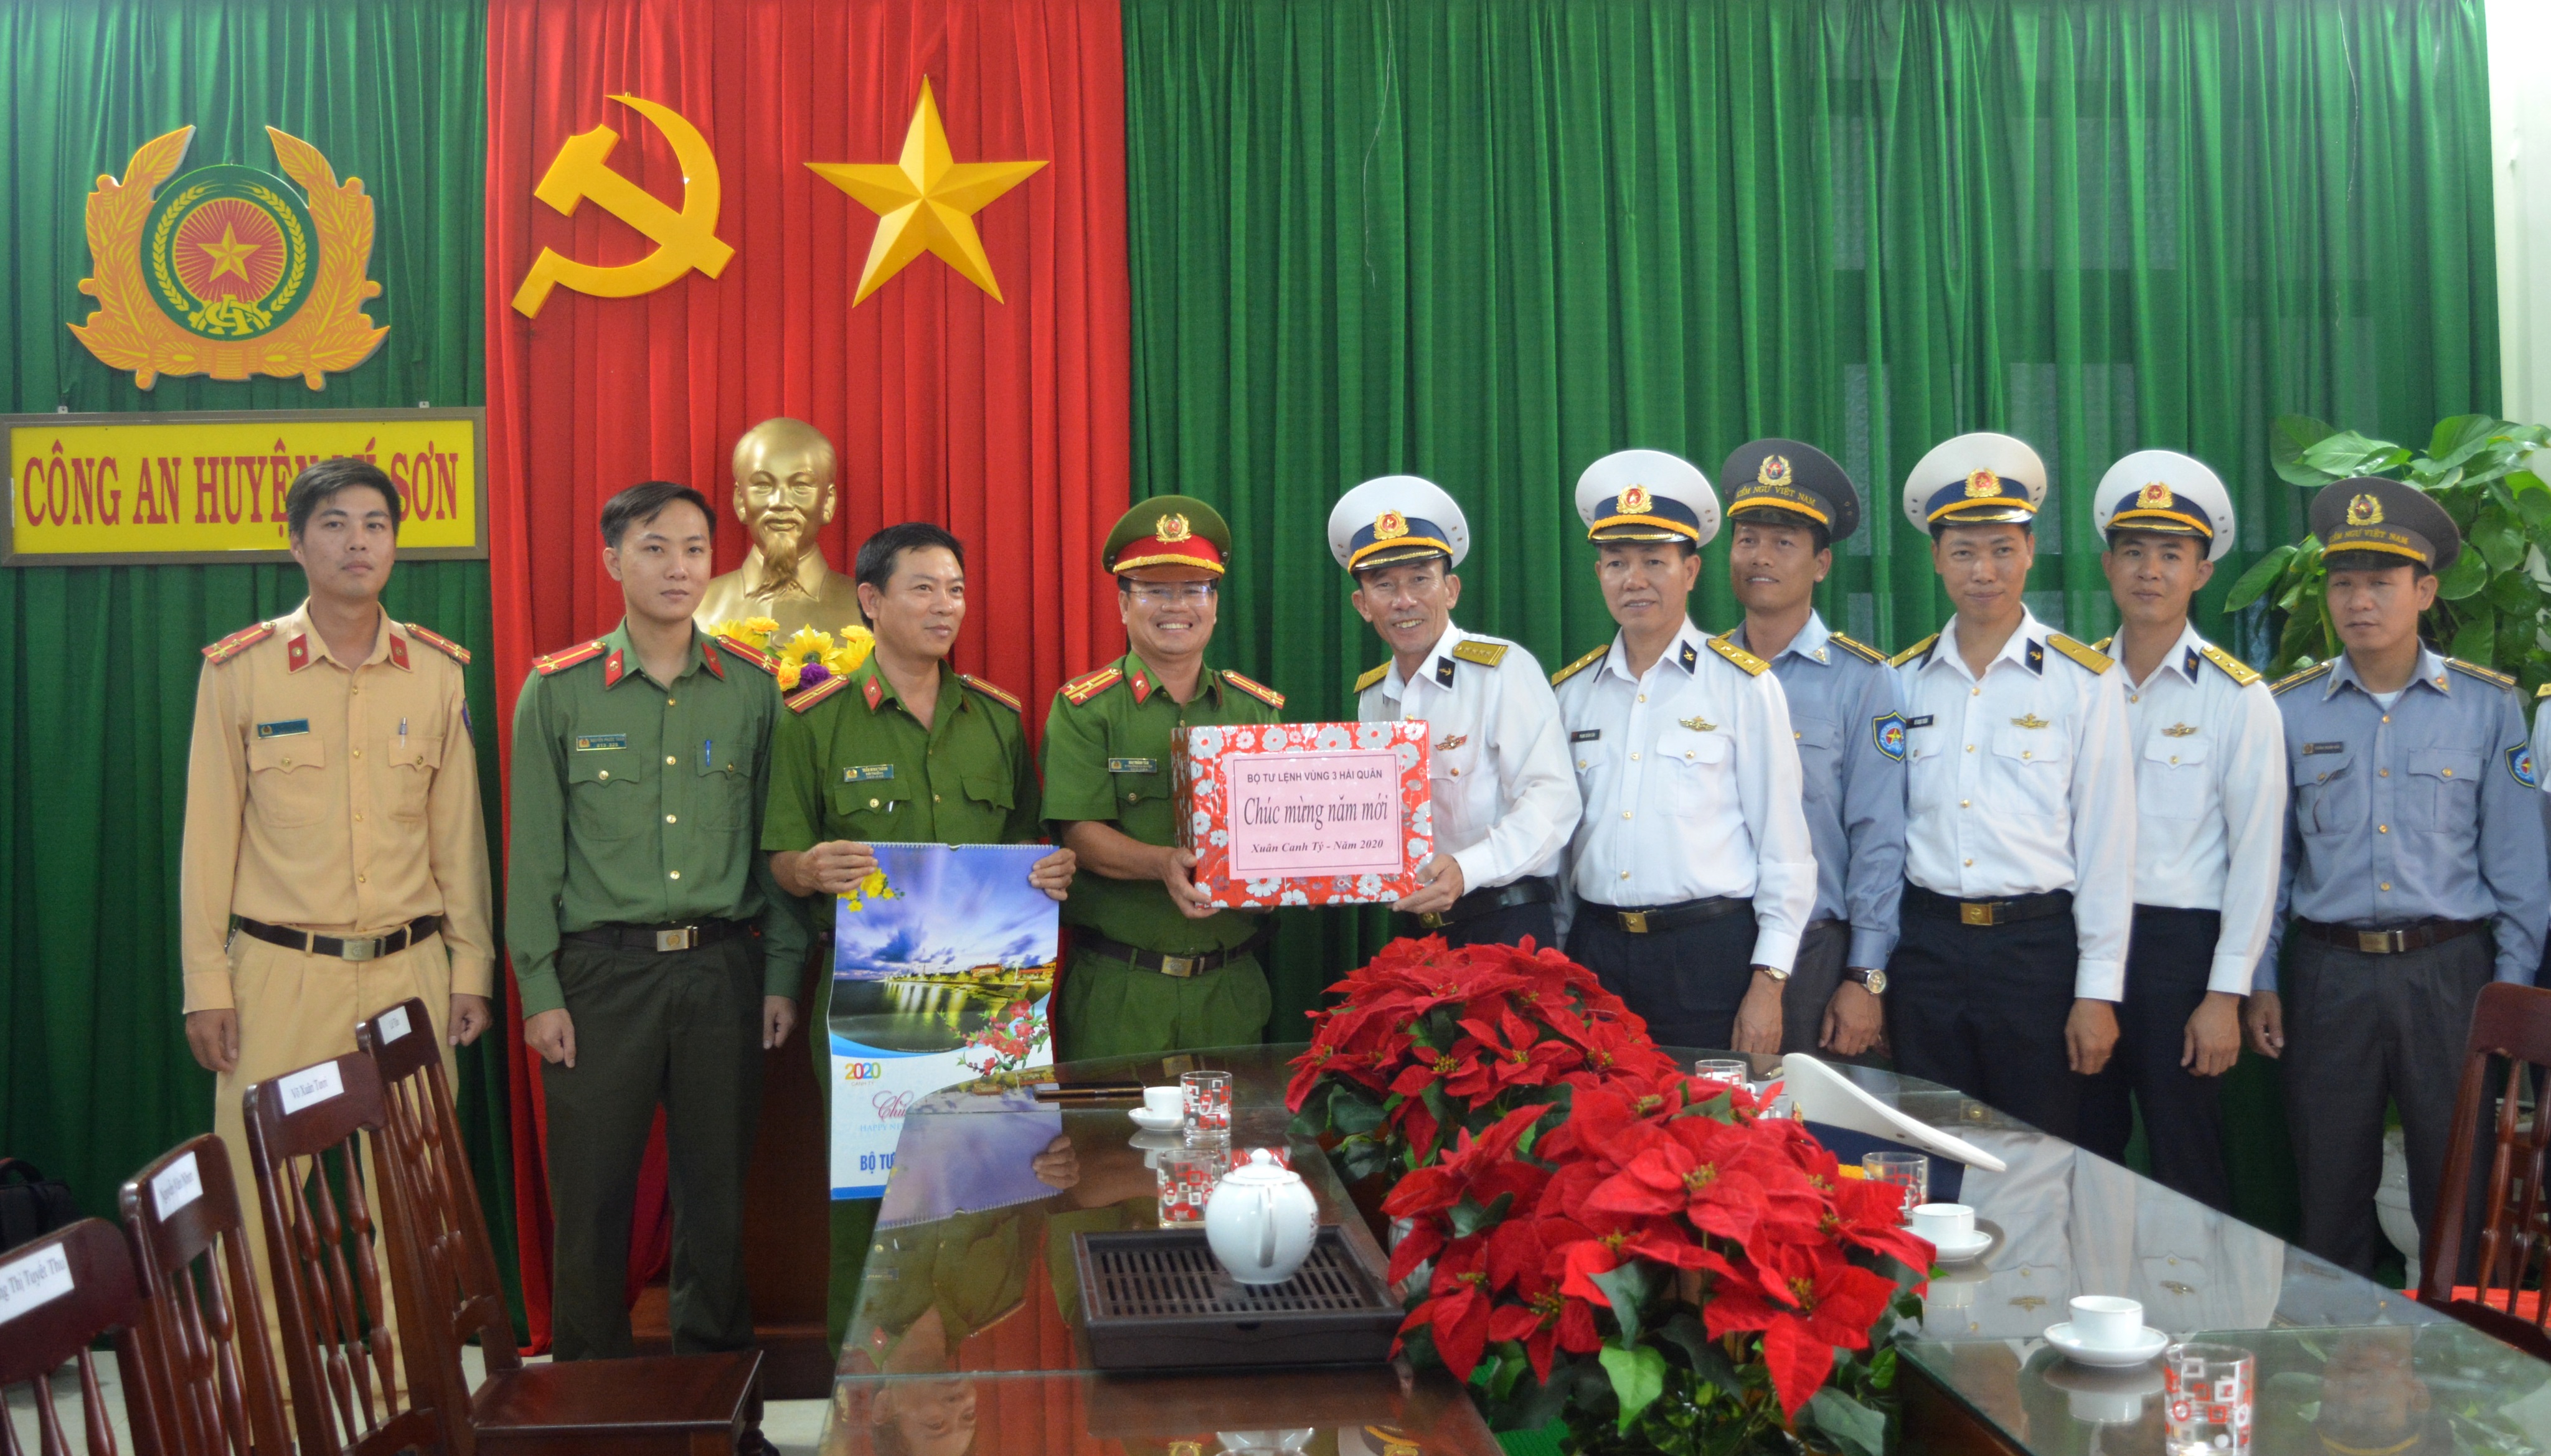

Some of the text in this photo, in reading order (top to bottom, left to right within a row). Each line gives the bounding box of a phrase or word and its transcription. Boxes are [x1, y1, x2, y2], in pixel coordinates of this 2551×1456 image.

[23, 437, 459, 538] CÔNG AN HUYỆ SƠN
[1775, 486, 1795, 497] VIỆT
[1798, 492, 1816, 506] NAM
[2389, 533, 2408, 545] NAM
[1247, 768, 1382, 784] BỘ TƯ LỆNH VÙNG 3 HẢI QUÂN
[1244, 792, 1388, 830] Chúc mừng năm mới
[1251, 843, 1278, 853] Xuân
[1281, 842, 1308, 852] Canh
[1312, 842, 1324, 853] Tý
[1334, 840, 1357, 850] Năm
[1360, 839, 1384, 849] 2020
[845, 1062, 882, 1080] 2020
[860, 1124, 888, 1132] HAPPY
[861, 1151, 875, 1174] BỘ
